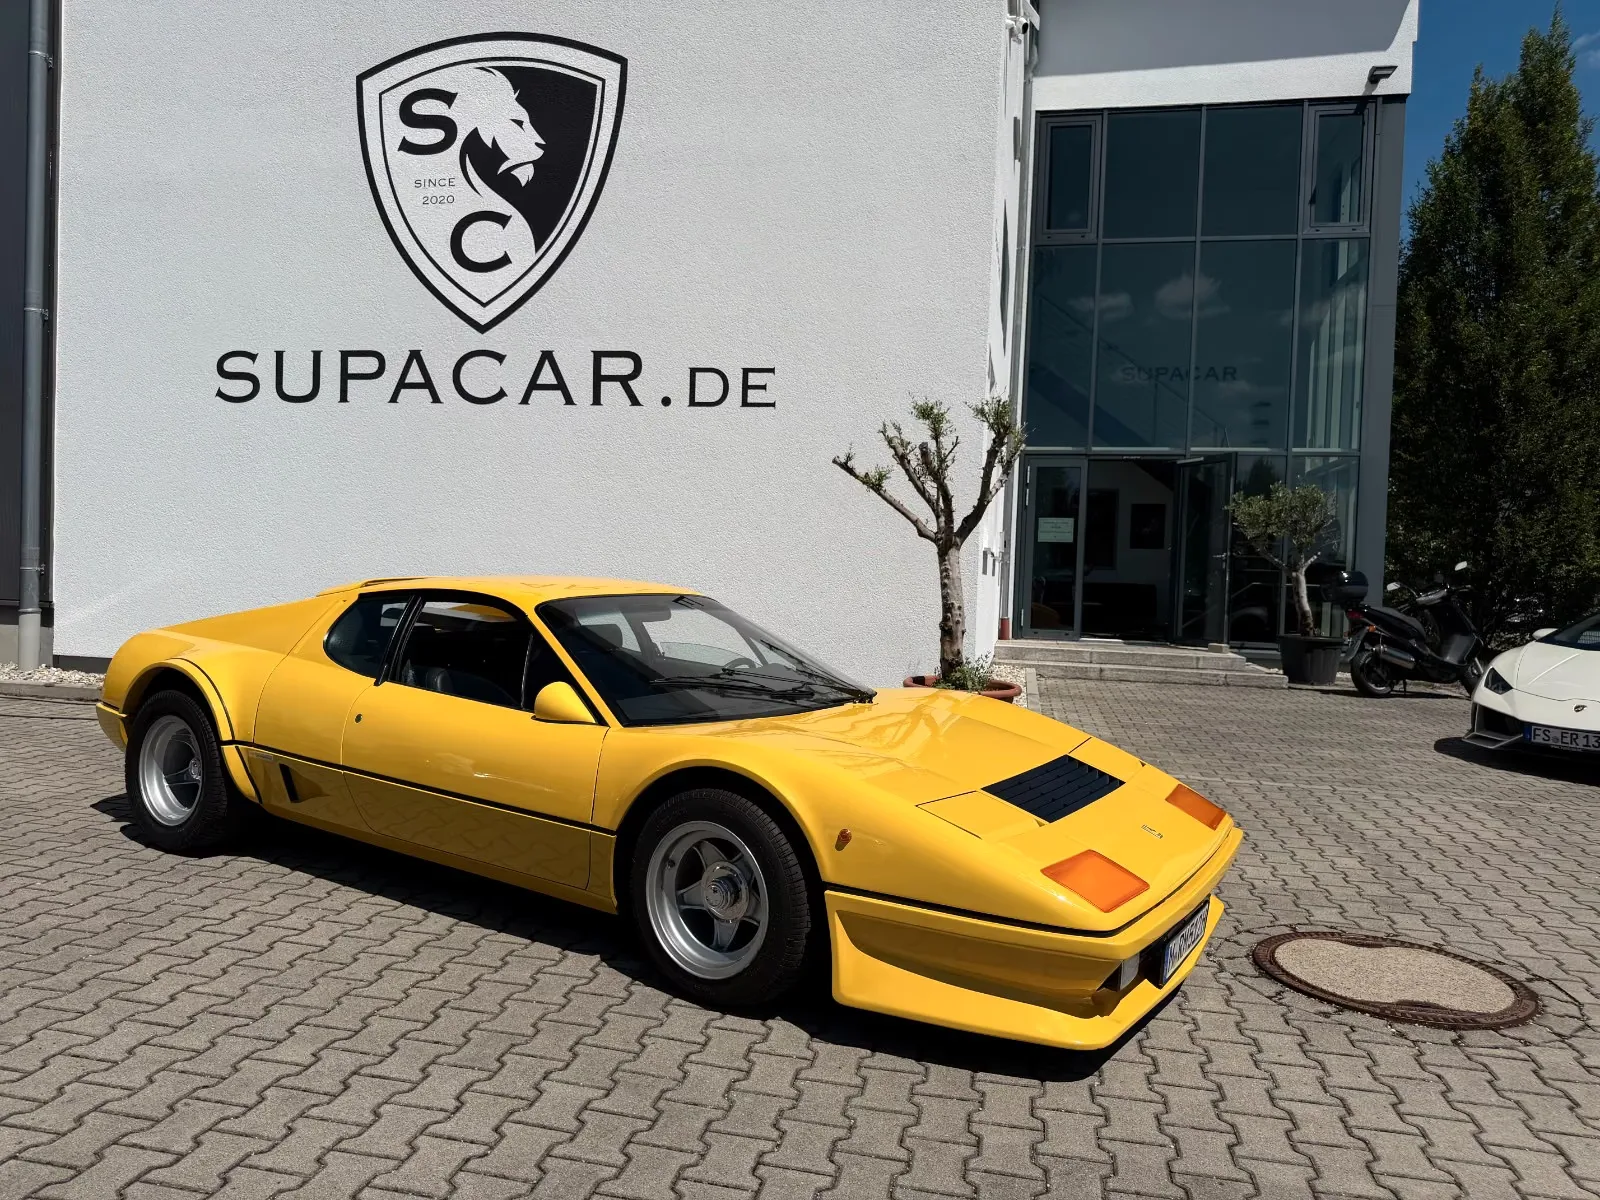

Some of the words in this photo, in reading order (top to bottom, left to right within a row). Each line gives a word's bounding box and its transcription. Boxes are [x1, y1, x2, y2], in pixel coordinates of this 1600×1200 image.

[398, 88, 458, 155] S
[414, 177, 456, 189] SINCE
[422, 195, 455, 205] 2020
[450, 210, 512, 273] C
[215, 349, 776, 408] SUPACAR.DE
[1533, 727, 1551, 742] FS
[1560, 731, 1579, 747] ER
